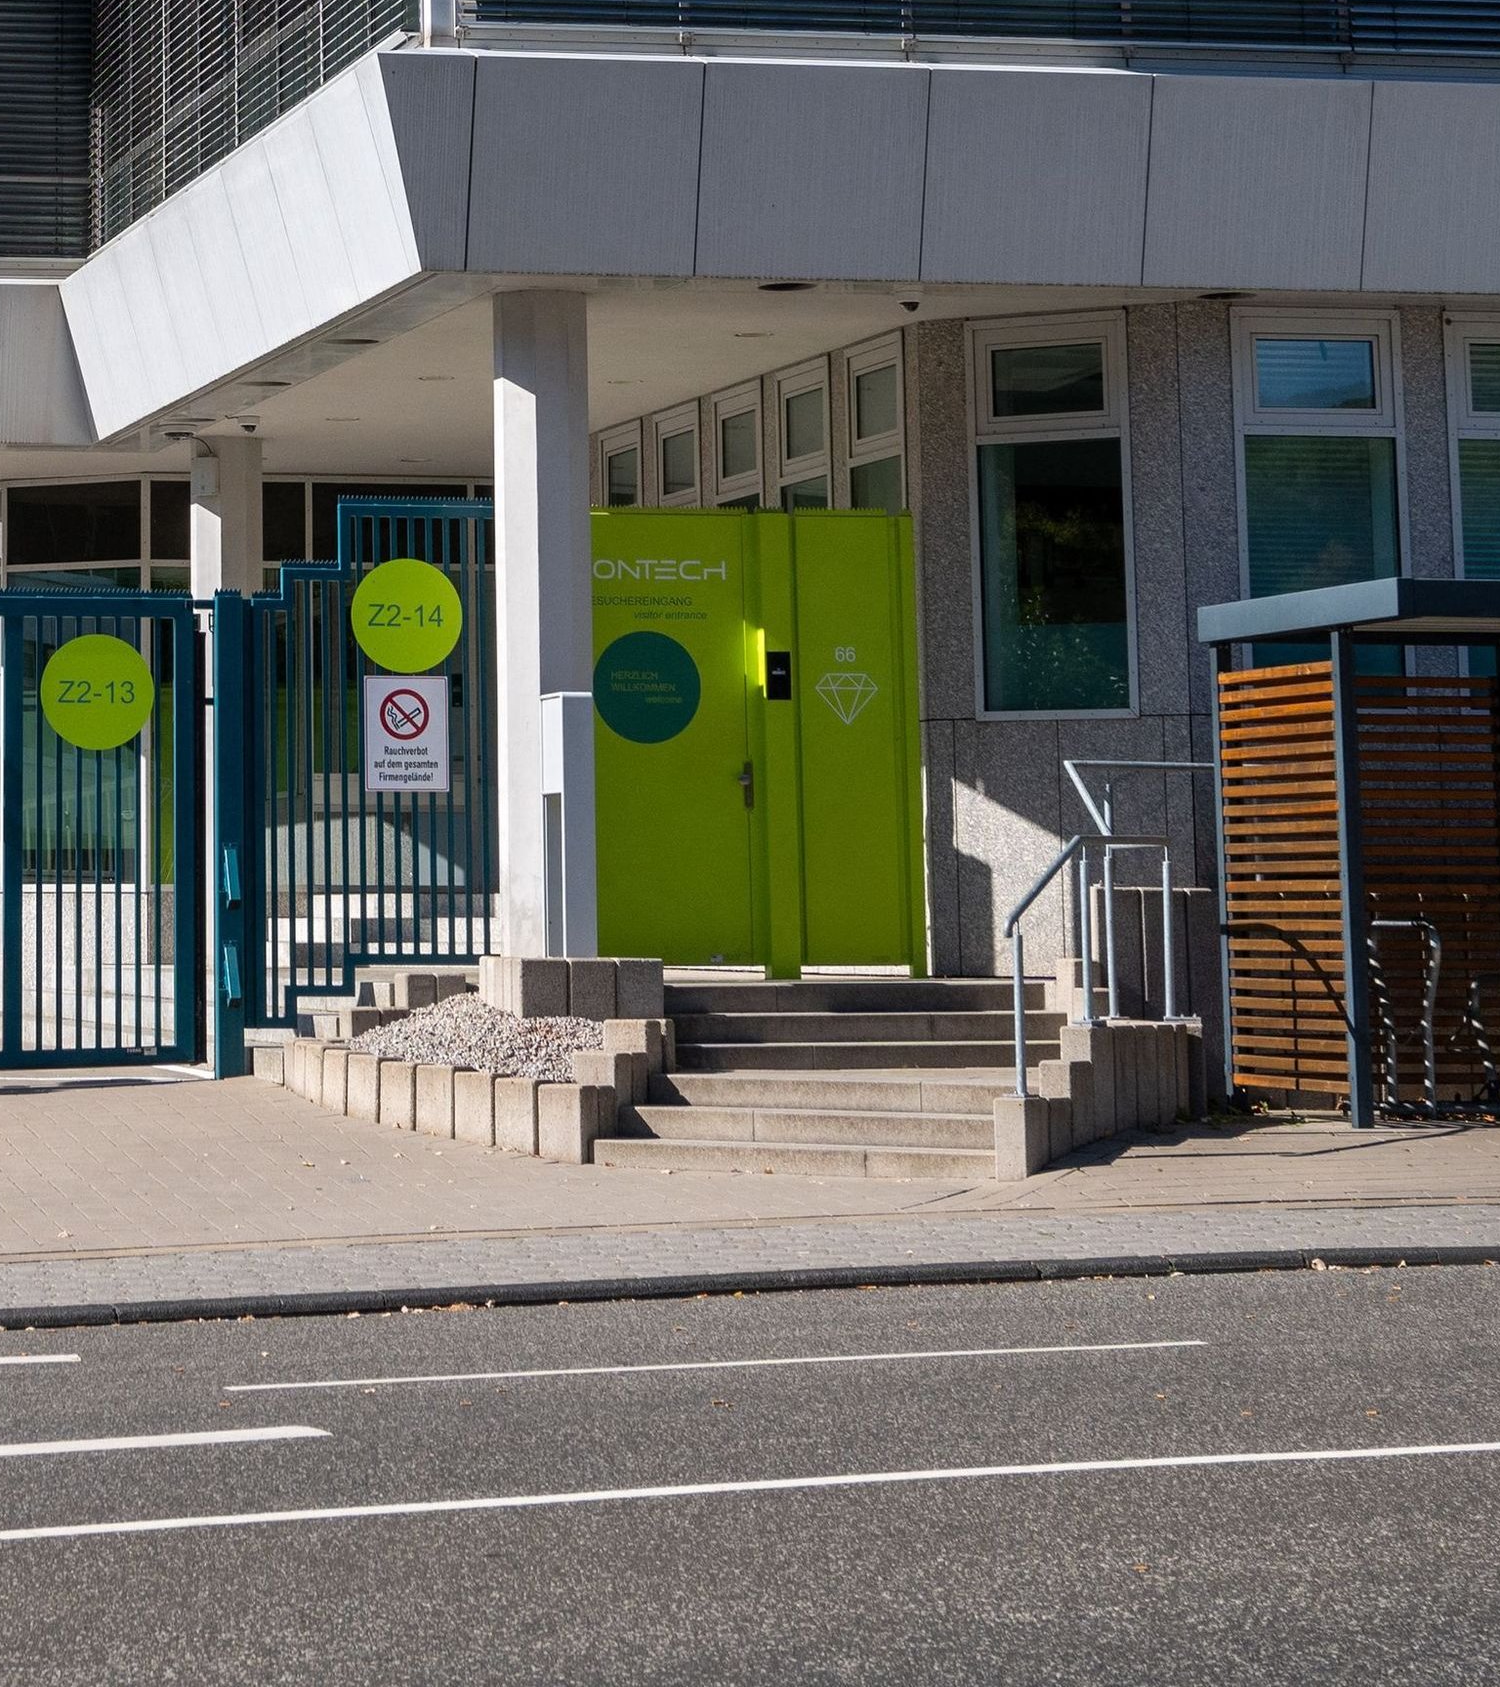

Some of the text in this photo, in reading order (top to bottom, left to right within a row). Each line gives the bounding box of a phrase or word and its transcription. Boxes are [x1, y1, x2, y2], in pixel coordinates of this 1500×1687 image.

[593, 559, 726, 580] ONTECH
[591, 596, 692, 606] ESUCHEREINGANG
[368, 604, 444, 627] Z2-14
[633, 611, 707, 620] visitor entrance
[835, 647, 856, 662] 66
[611, 672, 658, 680] HERZLICH
[58, 680, 135, 703] Z2-13
[611, 683, 676, 691] WILLKOMMEN
[384, 746, 428, 755] Rauchverbot
[374, 759, 438, 770] auf dem gesamten
[379, 772, 433, 783] Firmengelände!
